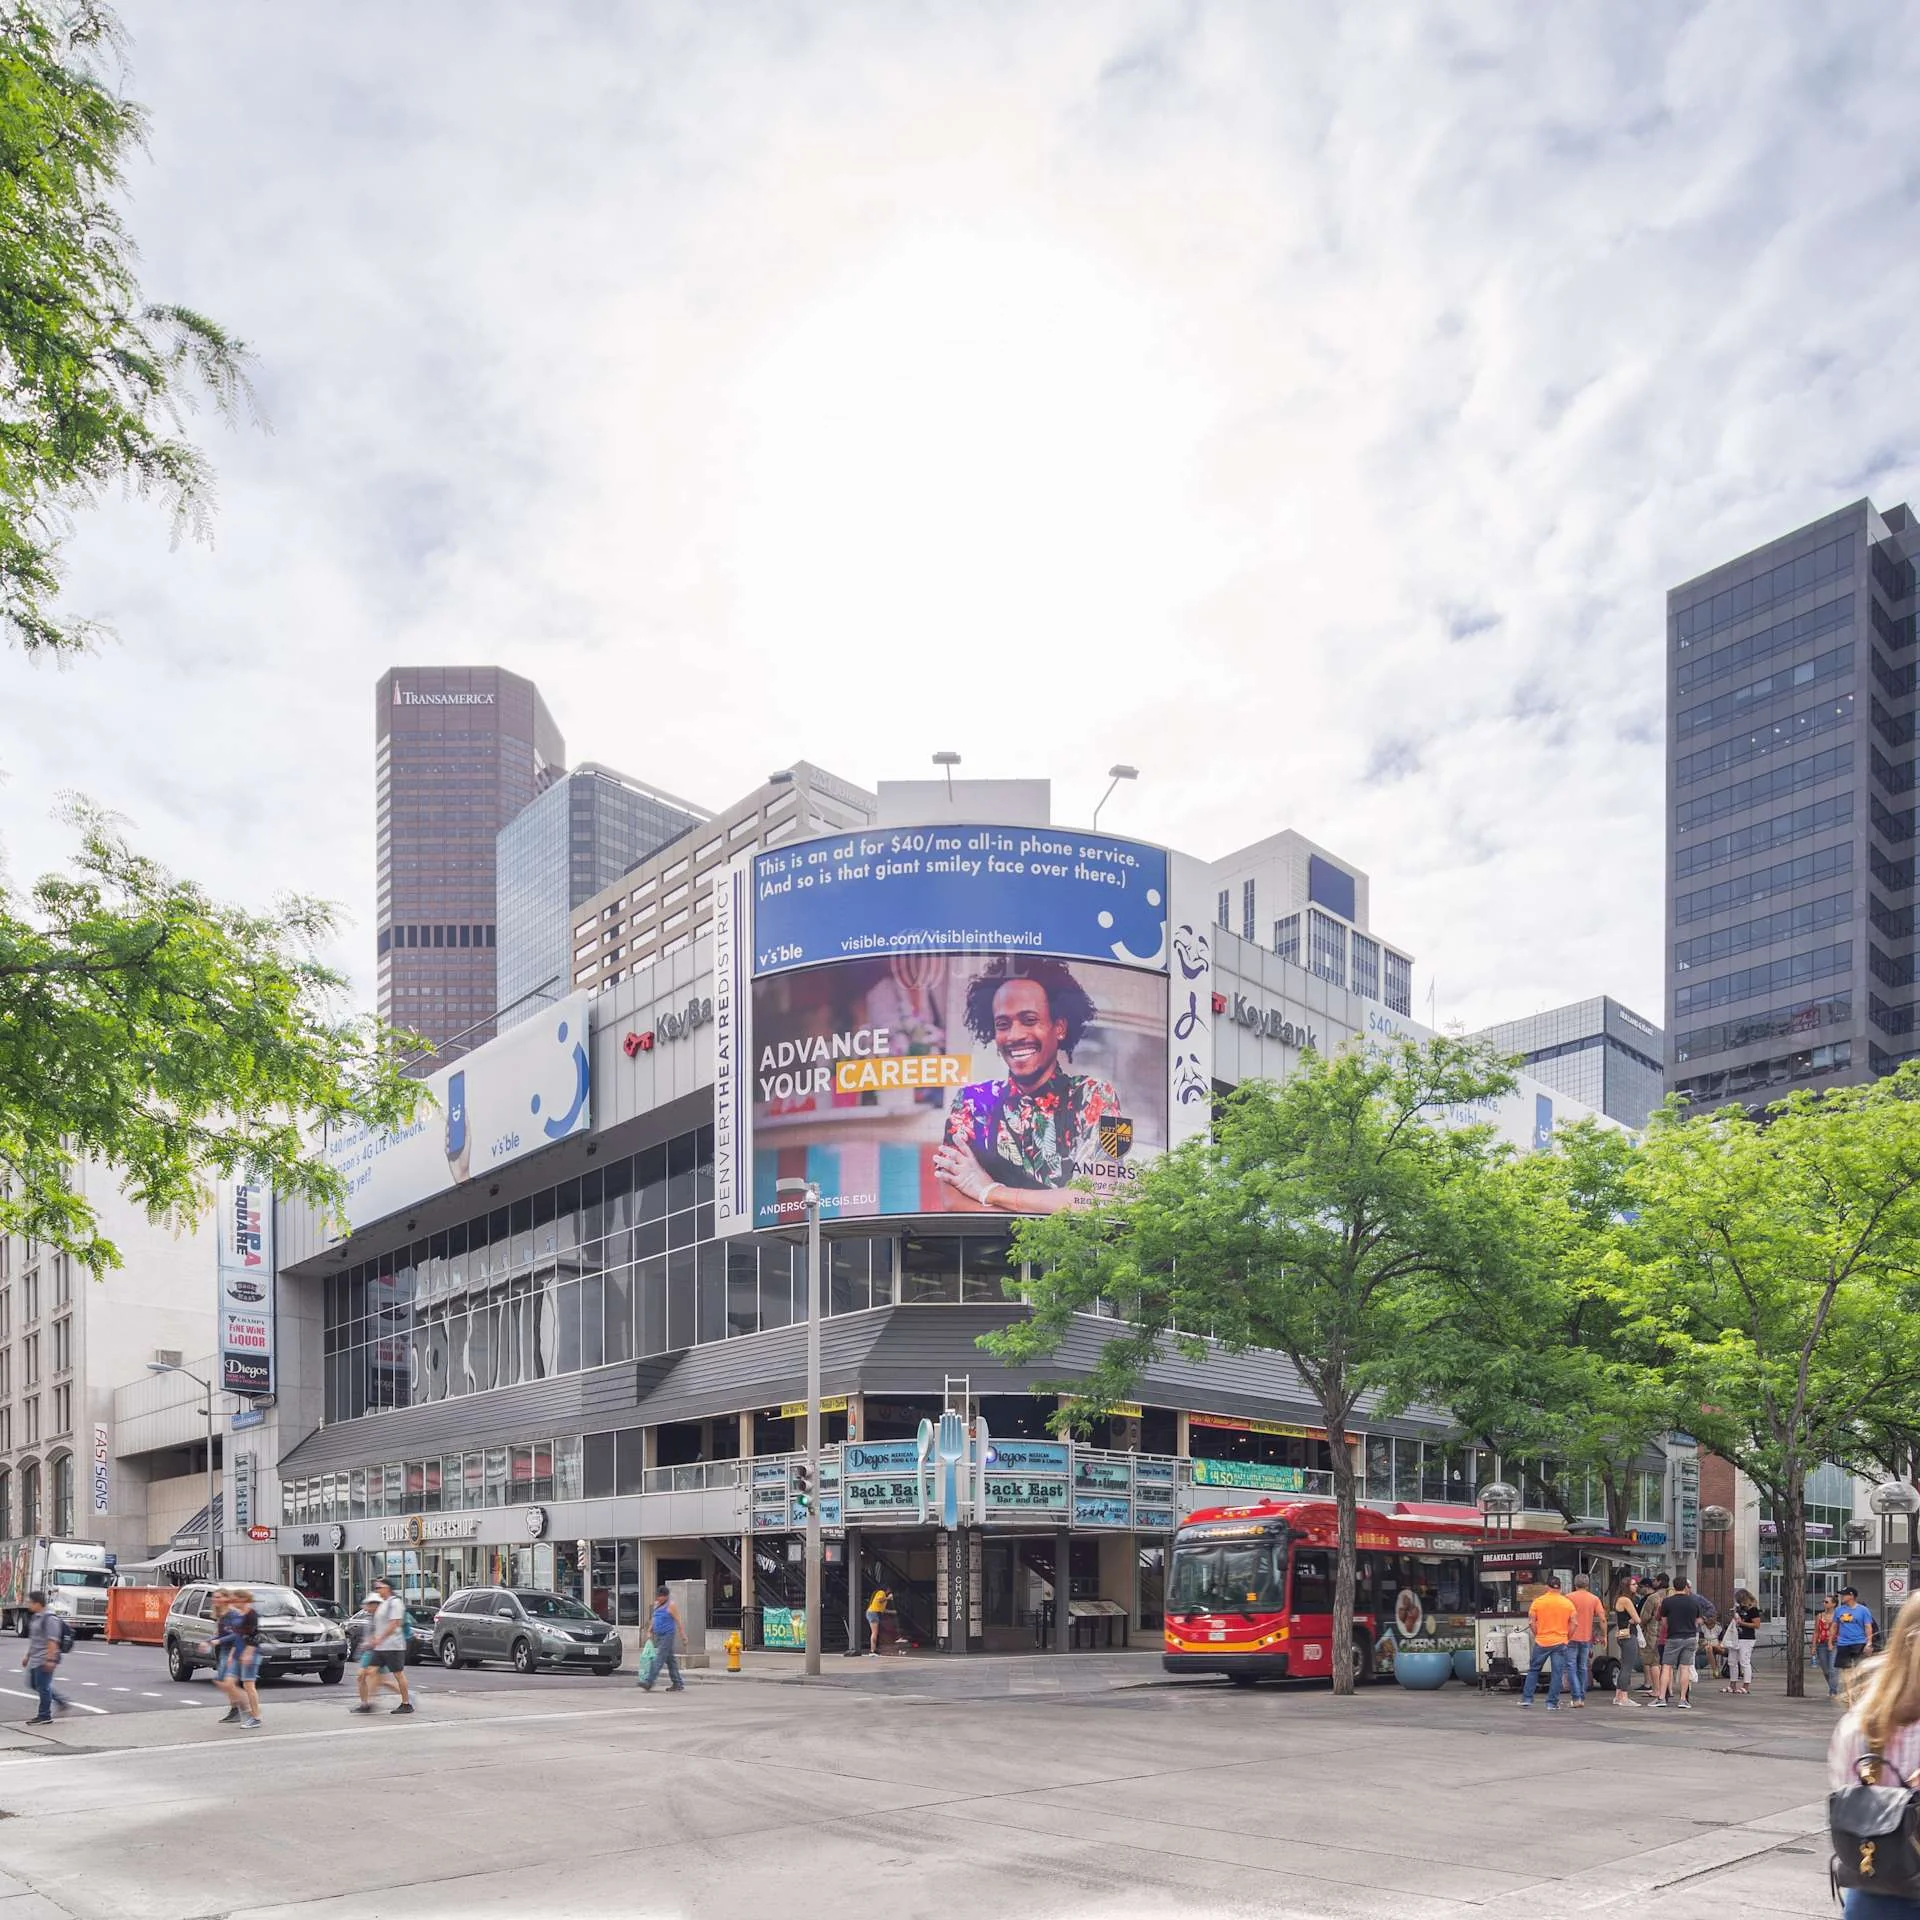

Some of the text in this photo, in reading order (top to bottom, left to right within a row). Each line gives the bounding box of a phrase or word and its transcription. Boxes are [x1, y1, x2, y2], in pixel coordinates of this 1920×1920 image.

[402, 691, 495, 705] TRANSAMERICA
[759, 832, 1140, 877] This is an ad for $40/mo all-in phone service.
[760, 854, 1127, 901] (And so is that giant smiley face over there.)
[840, 930, 1042, 951] visible.com/visibleinthewild
[656, 997, 714, 1046] KeyBa
[1230, 992, 1318, 1050] KeyBank
[759, 1028, 890, 1072] ADVANCE
[759, 1057, 968, 1102] YOUR CAREER.
[362, 1143, 373, 1161] 4G
[235, 1185, 248, 1256] SQUARE
[244, 1174, 261, 1267] HAMPA
[224, 1359, 268, 1379] Diegos
[96, 1428, 108, 1511] FASTSIGNS
[851, 1449, 890, 1470] Diegos
[850, 1484, 886, 1498] Back
[984, 1482, 1063, 1497] Back East
[380, 1523, 409, 1541] FLOYD'S
[421, 1518, 475, 1538] BARBERSHOP
[1638, 1531, 1667, 1545] OLORADO
[64, 1551, 98, 1561] Sysco
[1482, 1551, 1543, 1563] BREAKFAST BURRITOS
[954, 1575, 963, 1621] CHAMPA
